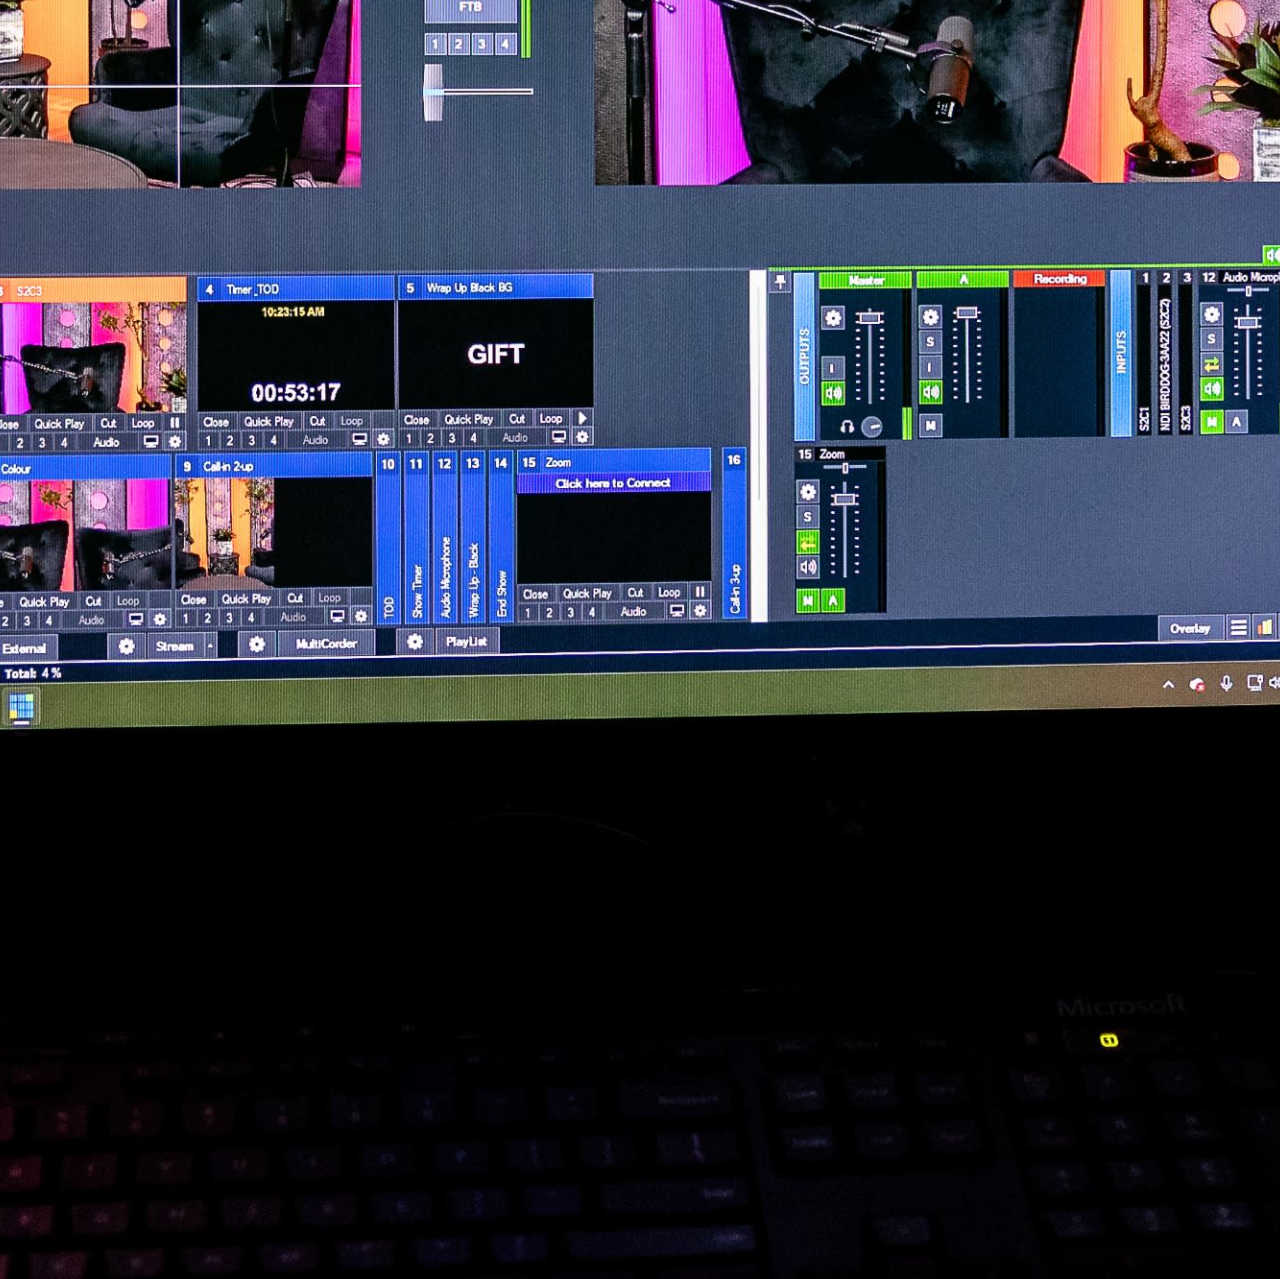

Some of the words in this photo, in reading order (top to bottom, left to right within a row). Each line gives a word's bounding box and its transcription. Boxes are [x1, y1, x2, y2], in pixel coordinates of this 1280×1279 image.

[459, 1, 482, 12] FTB
[1034, 274, 1088, 285] Recording
[1202, 273, 1216, 282] 12
[1223, 272, 1248, 282] Audio
[206, 285, 214, 295] 4
[406, 283, 414, 293] 5
[427, 283, 452, 295] Wrap
[454, 283, 468, 295] Up
[470, 283, 495, 293] Black
[498, 283, 513, 292] BG
[262, 307, 305, 317] 10:23:15
[307, 307, 325, 317] AM
[1160, 298, 1171, 330] (S2C2)
[468, 343, 526, 364] GIFT
[800, 328, 809, 385] OUTPUTS
[1116, 331, 1127, 374] INPUTS
[252, 383, 341, 402] 00:53:17
[404, 415, 430, 425] Close
[445, 415, 471, 425] Quick
[475, 415, 494, 426] Play
[509, 414, 526, 424] Cut
[540, 414, 563, 425] Loop
[1140, 407, 1149, 431] S2C1
[1160, 416, 1170, 431] NDI
[1181, 406, 1191, 431] S2C3
[503, 433, 528, 443] Audio
[799, 450, 812, 459] 15
[819, 449, 845, 459] Zoom
[382, 459, 395, 469] 10
[410, 459, 422, 469] 11
[438, 459, 451, 469] 12
[466, 458, 480, 468] 13
[494, 458, 507, 468] 14
[523, 457, 536, 467] 15
[545, 457, 571, 467] Zoom
[728, 455, 740, 465] 16
[1, 464, 31, 474] Colour
[184, 462, 191, 471] 9
[555, 478, 582, 489] Click
[586, 478, 610, 489] here
[613, 479, 624, 488] to
[627, 478, 671, 488] Connect
[523, 590, 548, 599] Close
[563, 589, 590, 599] Quick
[593, 588, 612, 600] Play
[628, 588, 644, 598] Cut
[658, 588, 680, 598] Loop
[384, 597, 394, 619] TOD
[621, 606, 646, 616] Audio
[1170, 623, 1210, 635] Overlay
[2, 643, 47, 654] External
[156, 641, 195, 652] Stream
[296, 638, 358, 649] MultiCorder
[5, 669, 36, 679] Total:
[42, 668, 49, 678] 4
[51, 668, 61, 678] %
